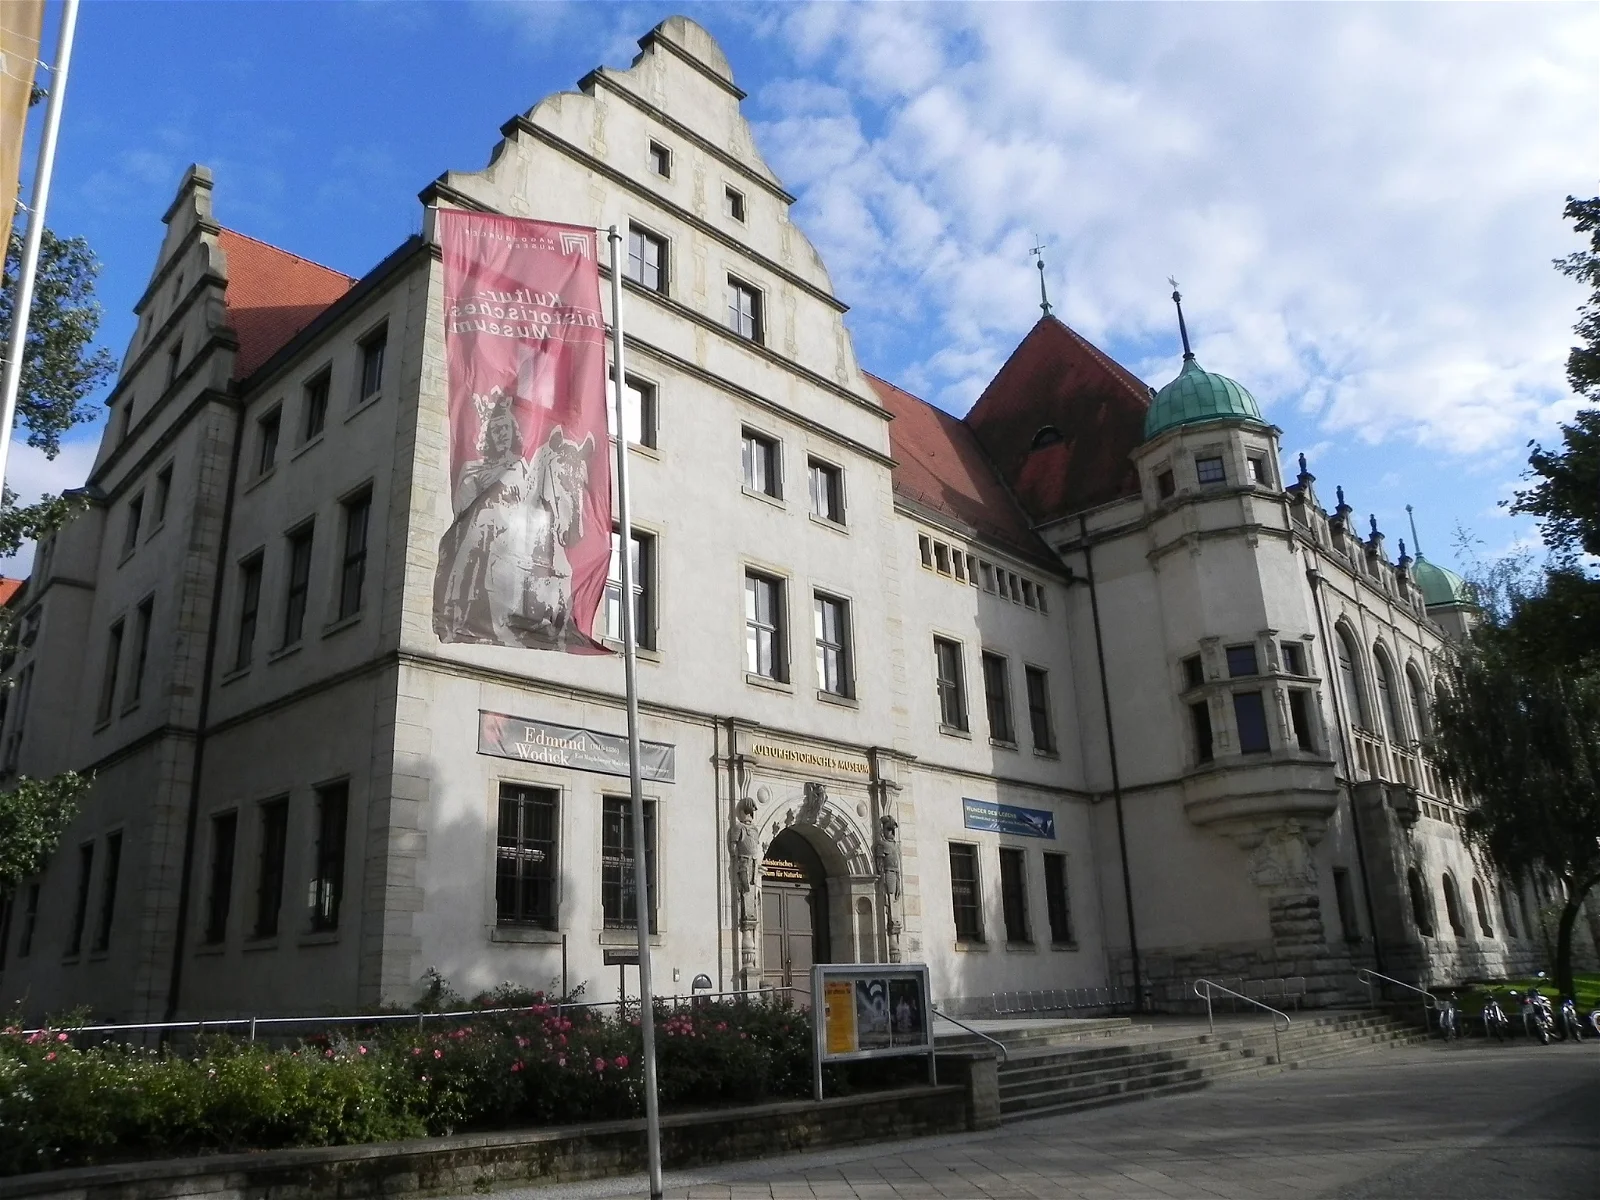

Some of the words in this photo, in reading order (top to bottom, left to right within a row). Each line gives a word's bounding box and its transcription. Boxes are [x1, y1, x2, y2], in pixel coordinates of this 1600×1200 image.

[524, 726, 586, 752] Edmund
[515, 742, 570, 766] Wodick
[752, 743, 837, 768] KULTURHISTORISCHES
[837, 760, 872, 774] MUSEUM
